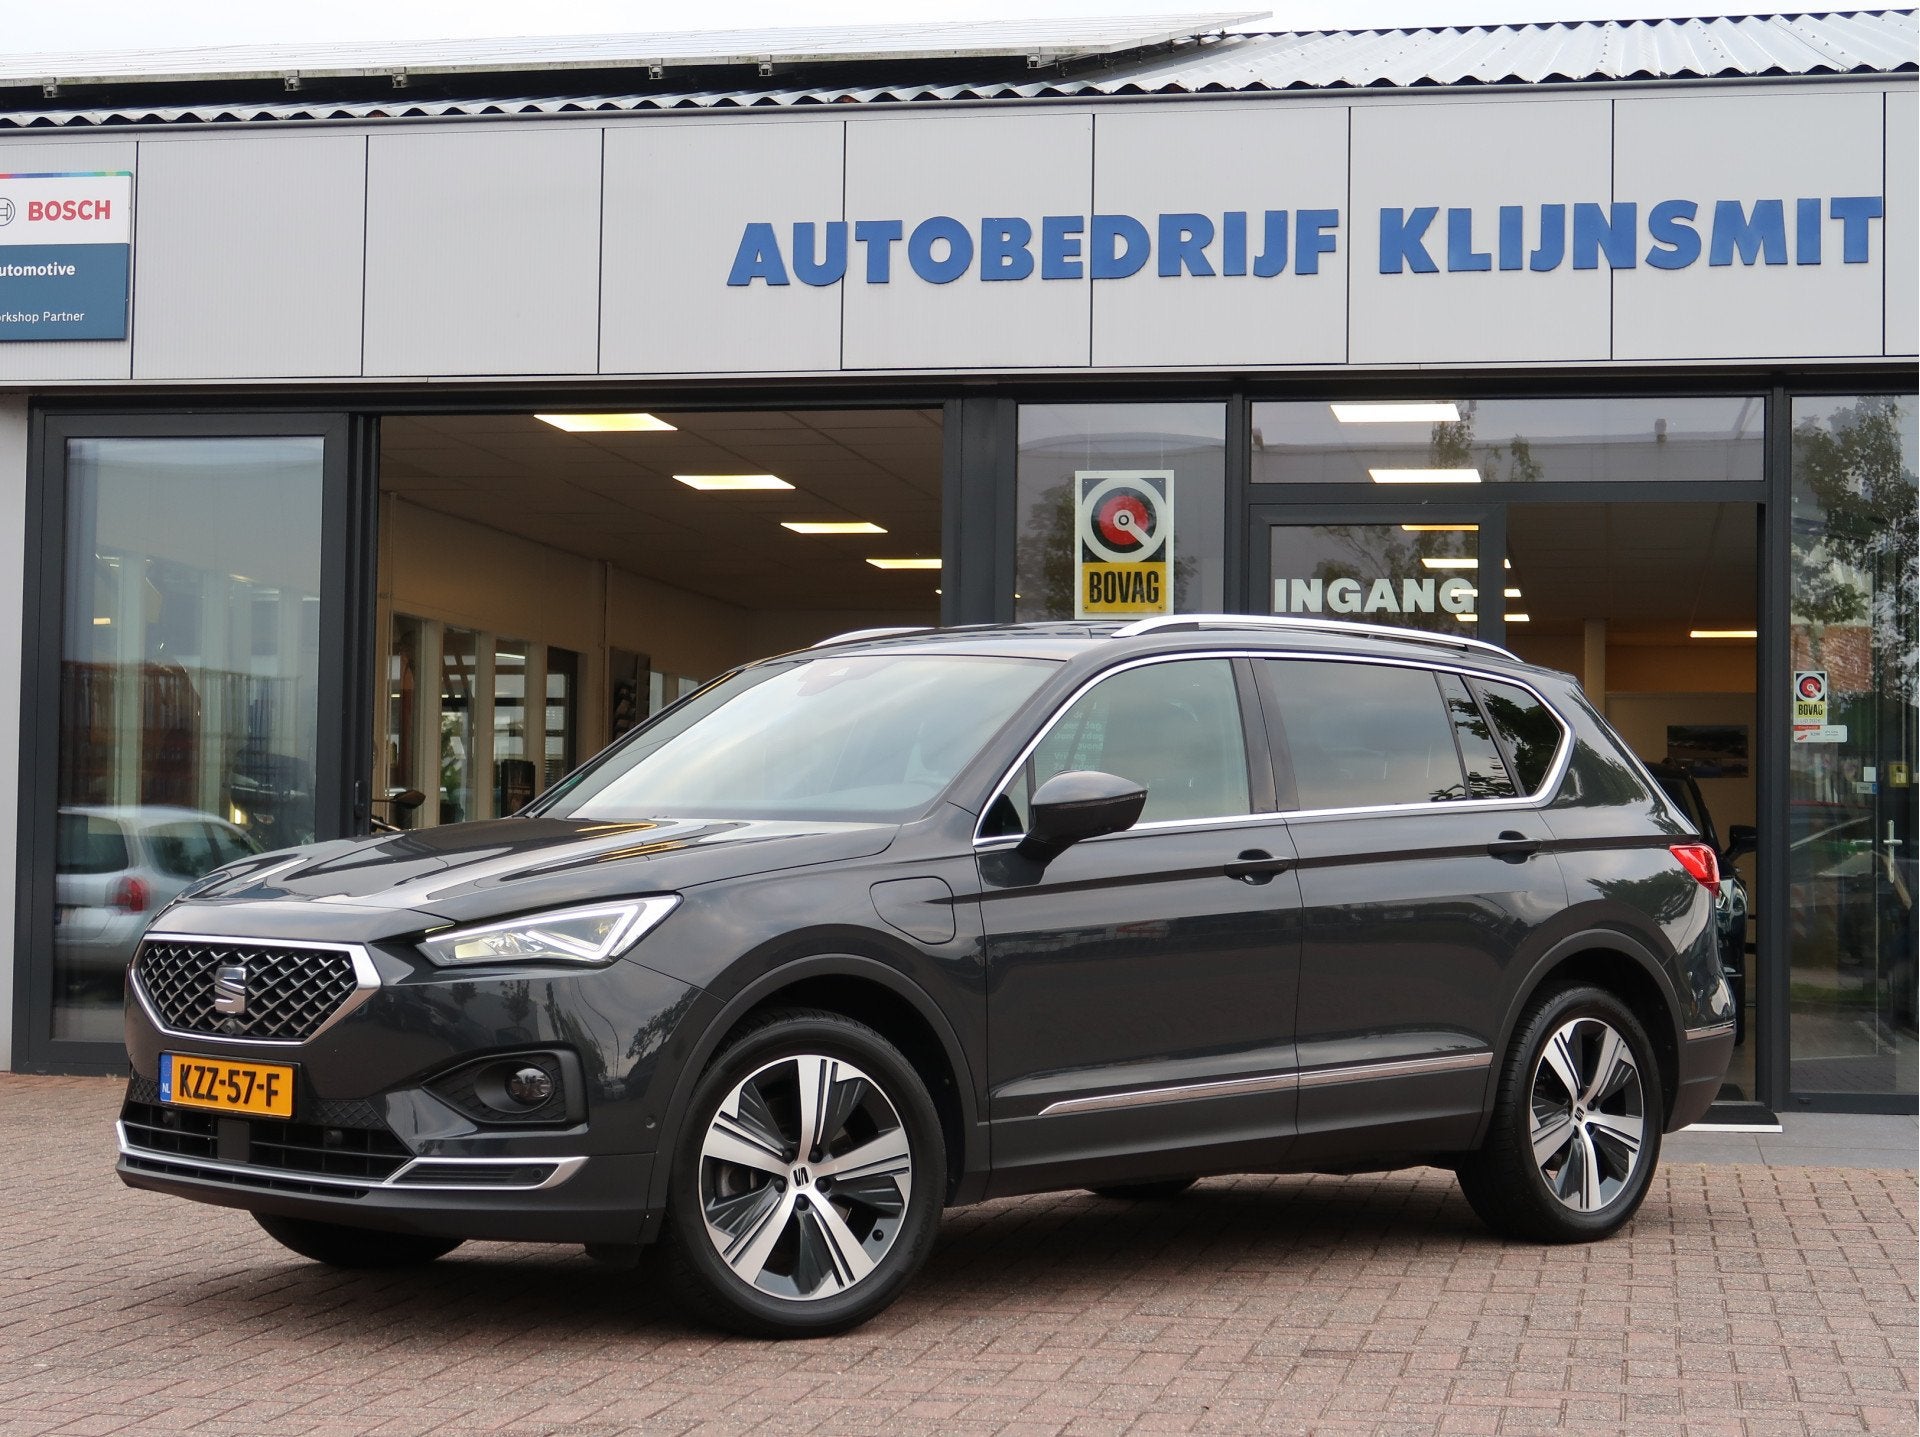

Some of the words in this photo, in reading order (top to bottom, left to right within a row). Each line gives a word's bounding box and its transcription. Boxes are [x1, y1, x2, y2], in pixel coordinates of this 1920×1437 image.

[28, 200, 111, 221] BOSCH
[727, 208, 1339, 287] AUTOBEDRIJF
[1379, 196, 1883, 274] KLIJNSMIT
[0, 311, 39, 324] rkshop
[43, 311, 85, 322] Partner
[1089, 570, 1159, 604] BOVAG
[1274, 577, 1475, 614] INGANG
[1798, 703, 1823, 716] BOVAG
[161, 1082, 171, 1094] NL
[179, 1063, 280, 1107] KZZ-57-F
